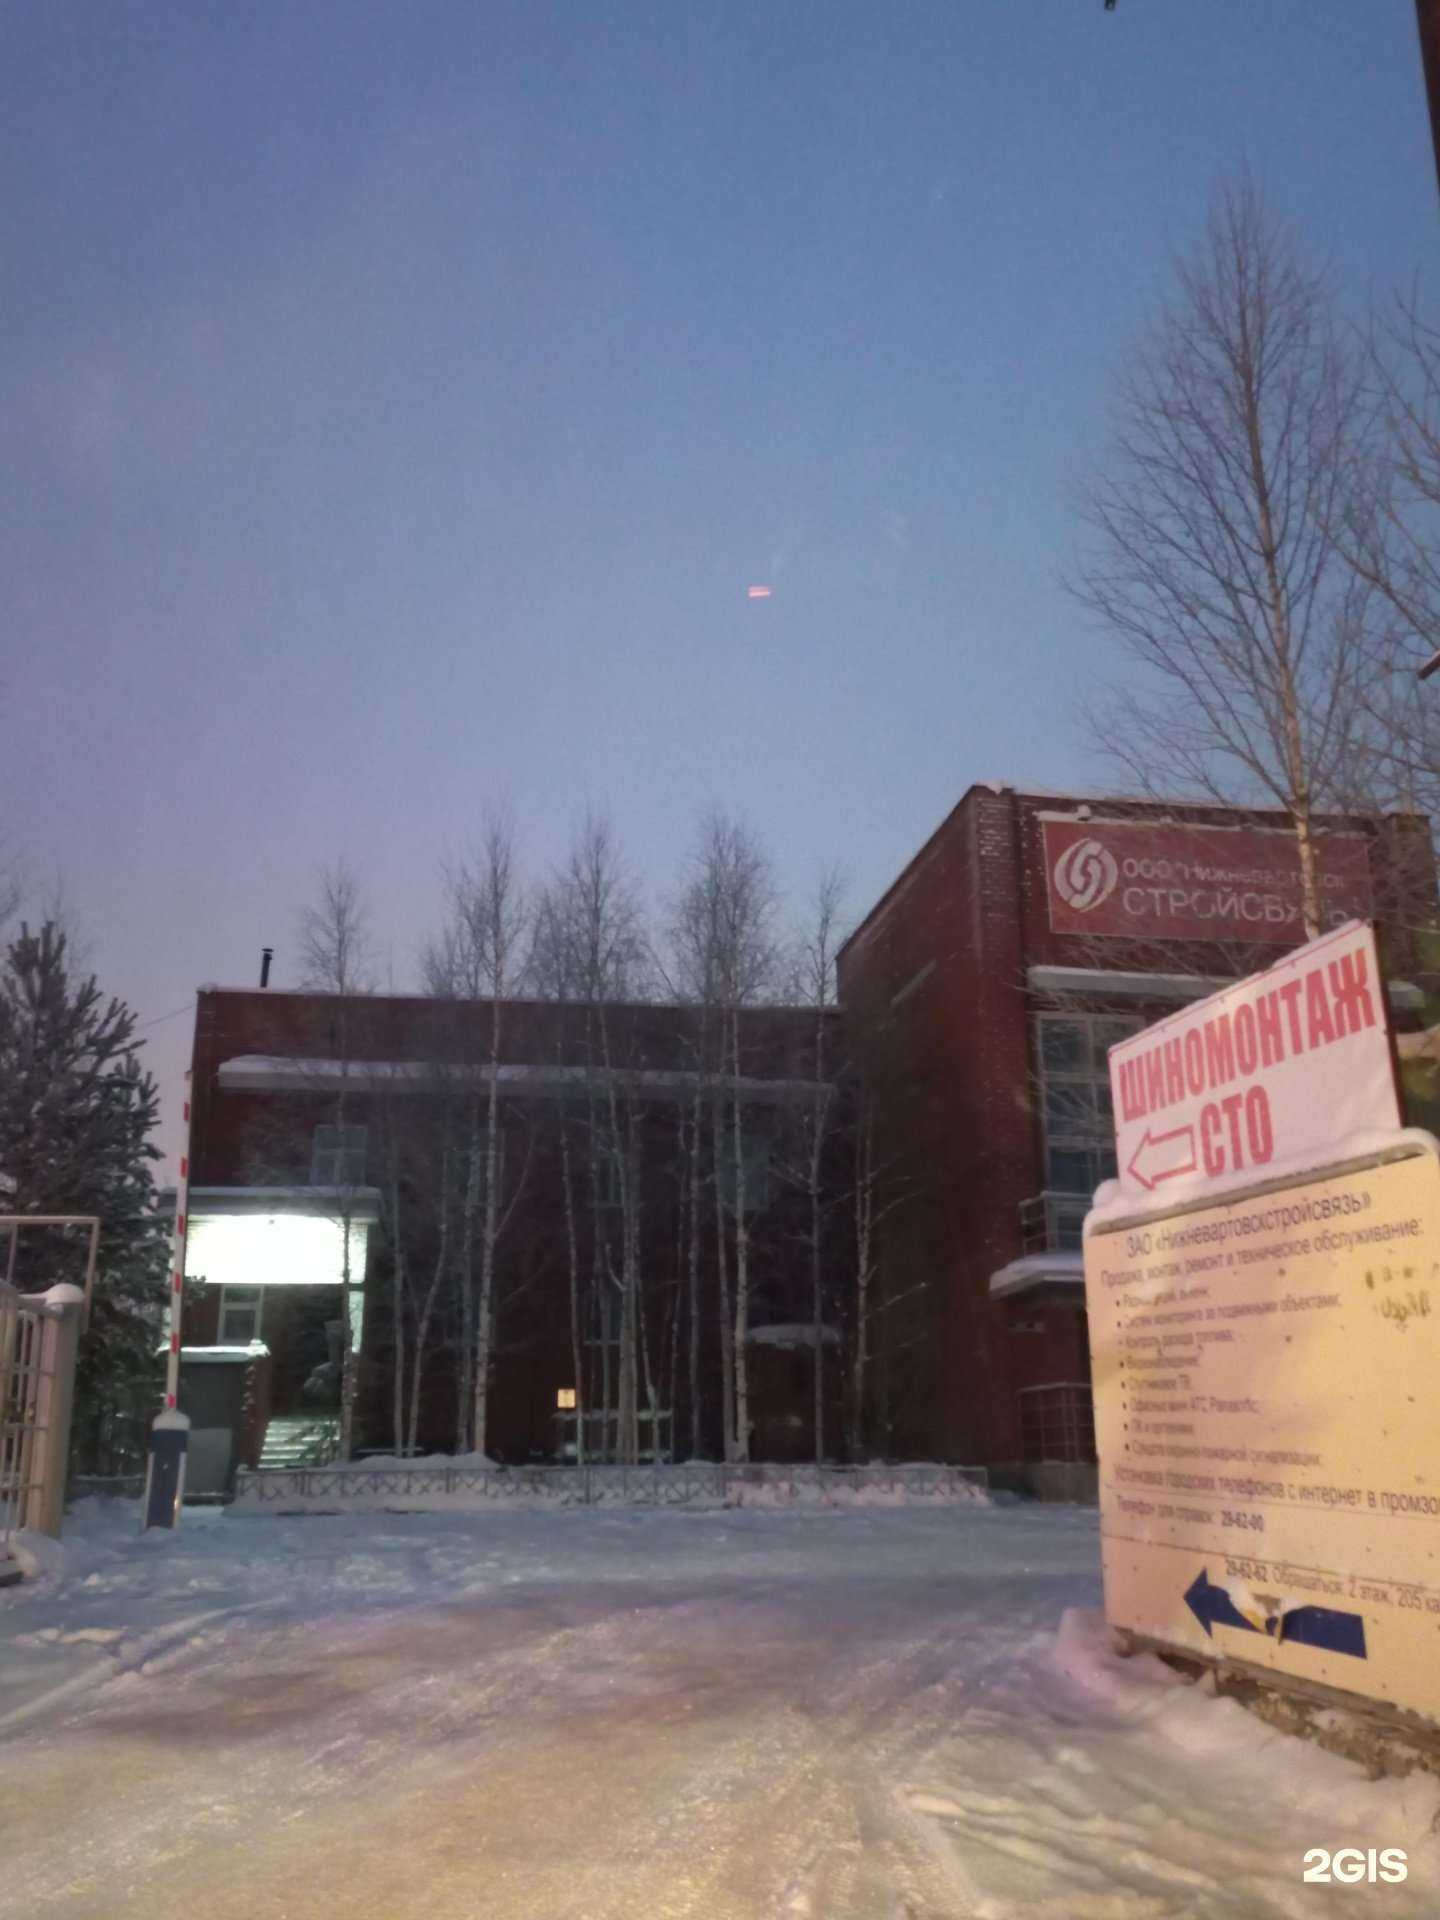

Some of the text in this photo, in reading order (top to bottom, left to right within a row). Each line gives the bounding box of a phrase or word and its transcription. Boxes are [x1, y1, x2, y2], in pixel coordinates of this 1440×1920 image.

[1118, 947, 1376, 1122] ШИНОМОНТАЖ
[1201, 1085, 1274, 1178] СТО
[1127, 1232, 1151, 1258] ЗАО
[1299, 1485, 1362, 1508] интернет
[1367, 1491, 1377, 1508] в
